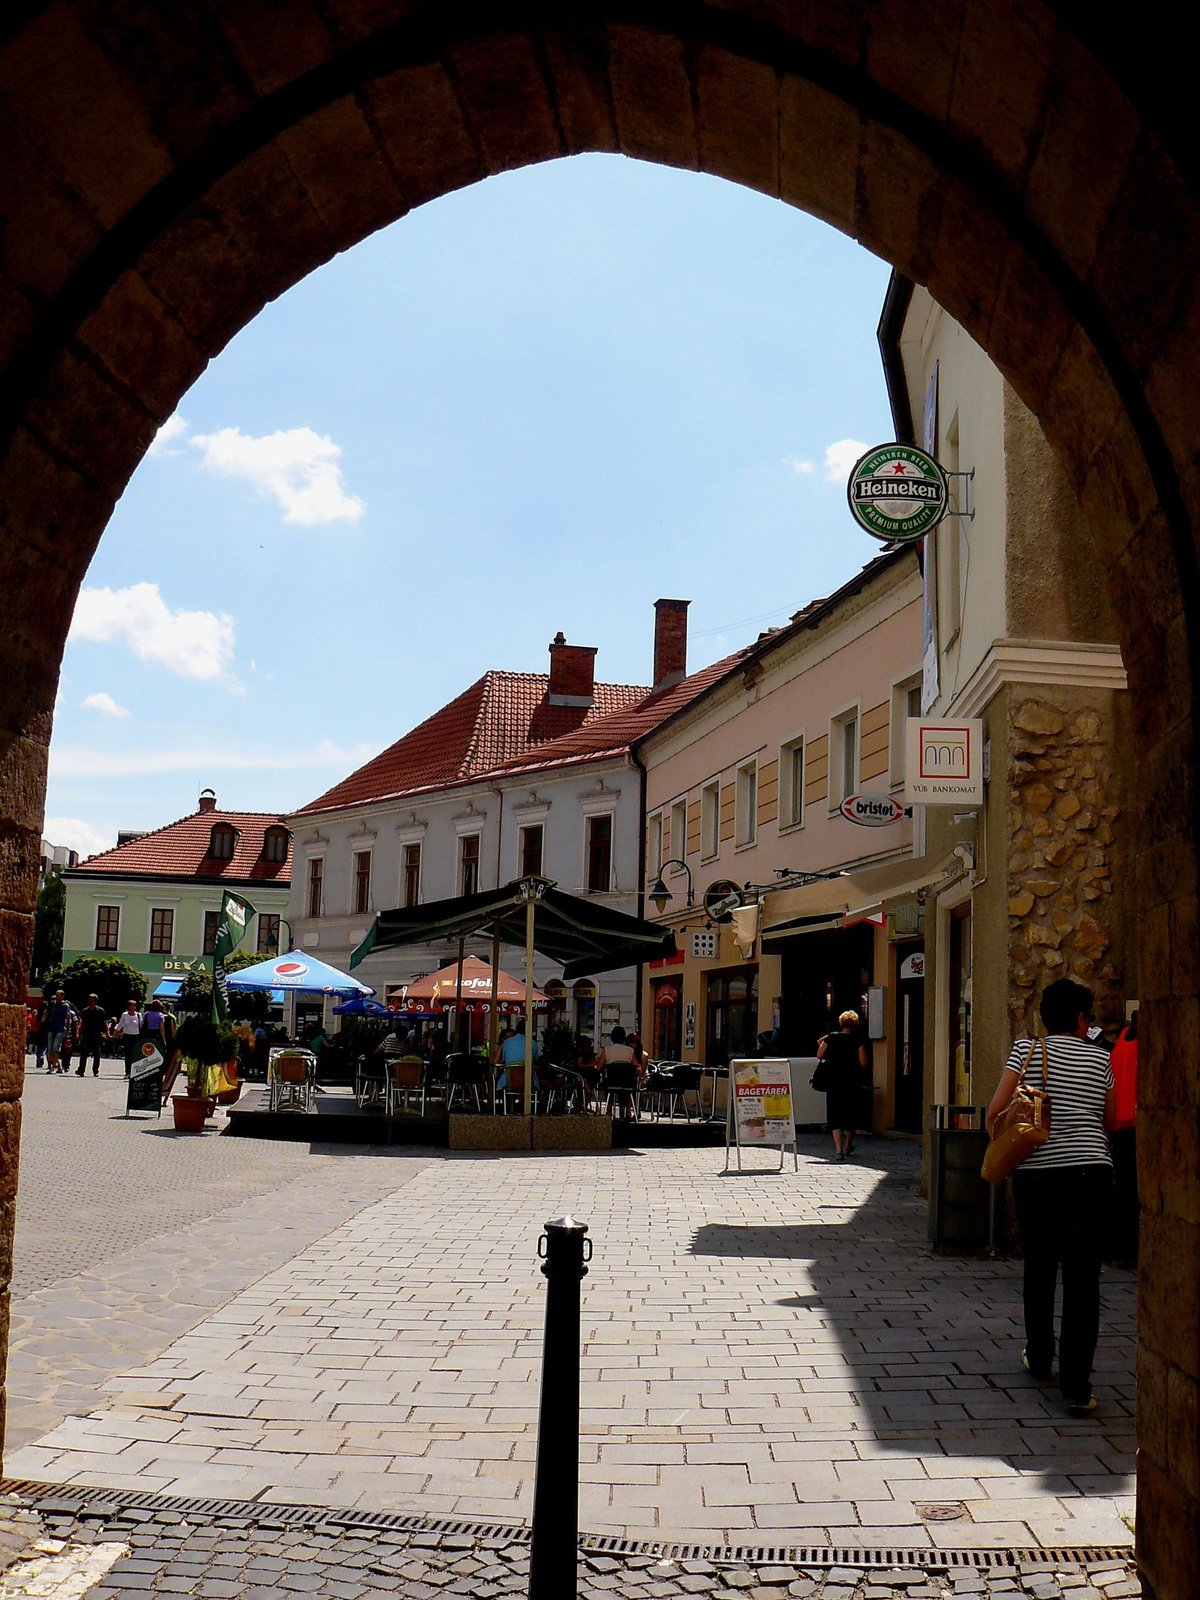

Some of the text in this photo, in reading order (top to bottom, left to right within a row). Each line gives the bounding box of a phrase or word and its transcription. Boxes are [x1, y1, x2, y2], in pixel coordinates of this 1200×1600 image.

[869, 452, 928, 470] HEINEKEN BEER
[860, 481, 937, 498] Heineken
[865, 506, 932, 531] PREMIUM QUALITY
[913, 783, 977, 794] VÚB BANKOMAT
[856, 800, 895, 817] bristot
